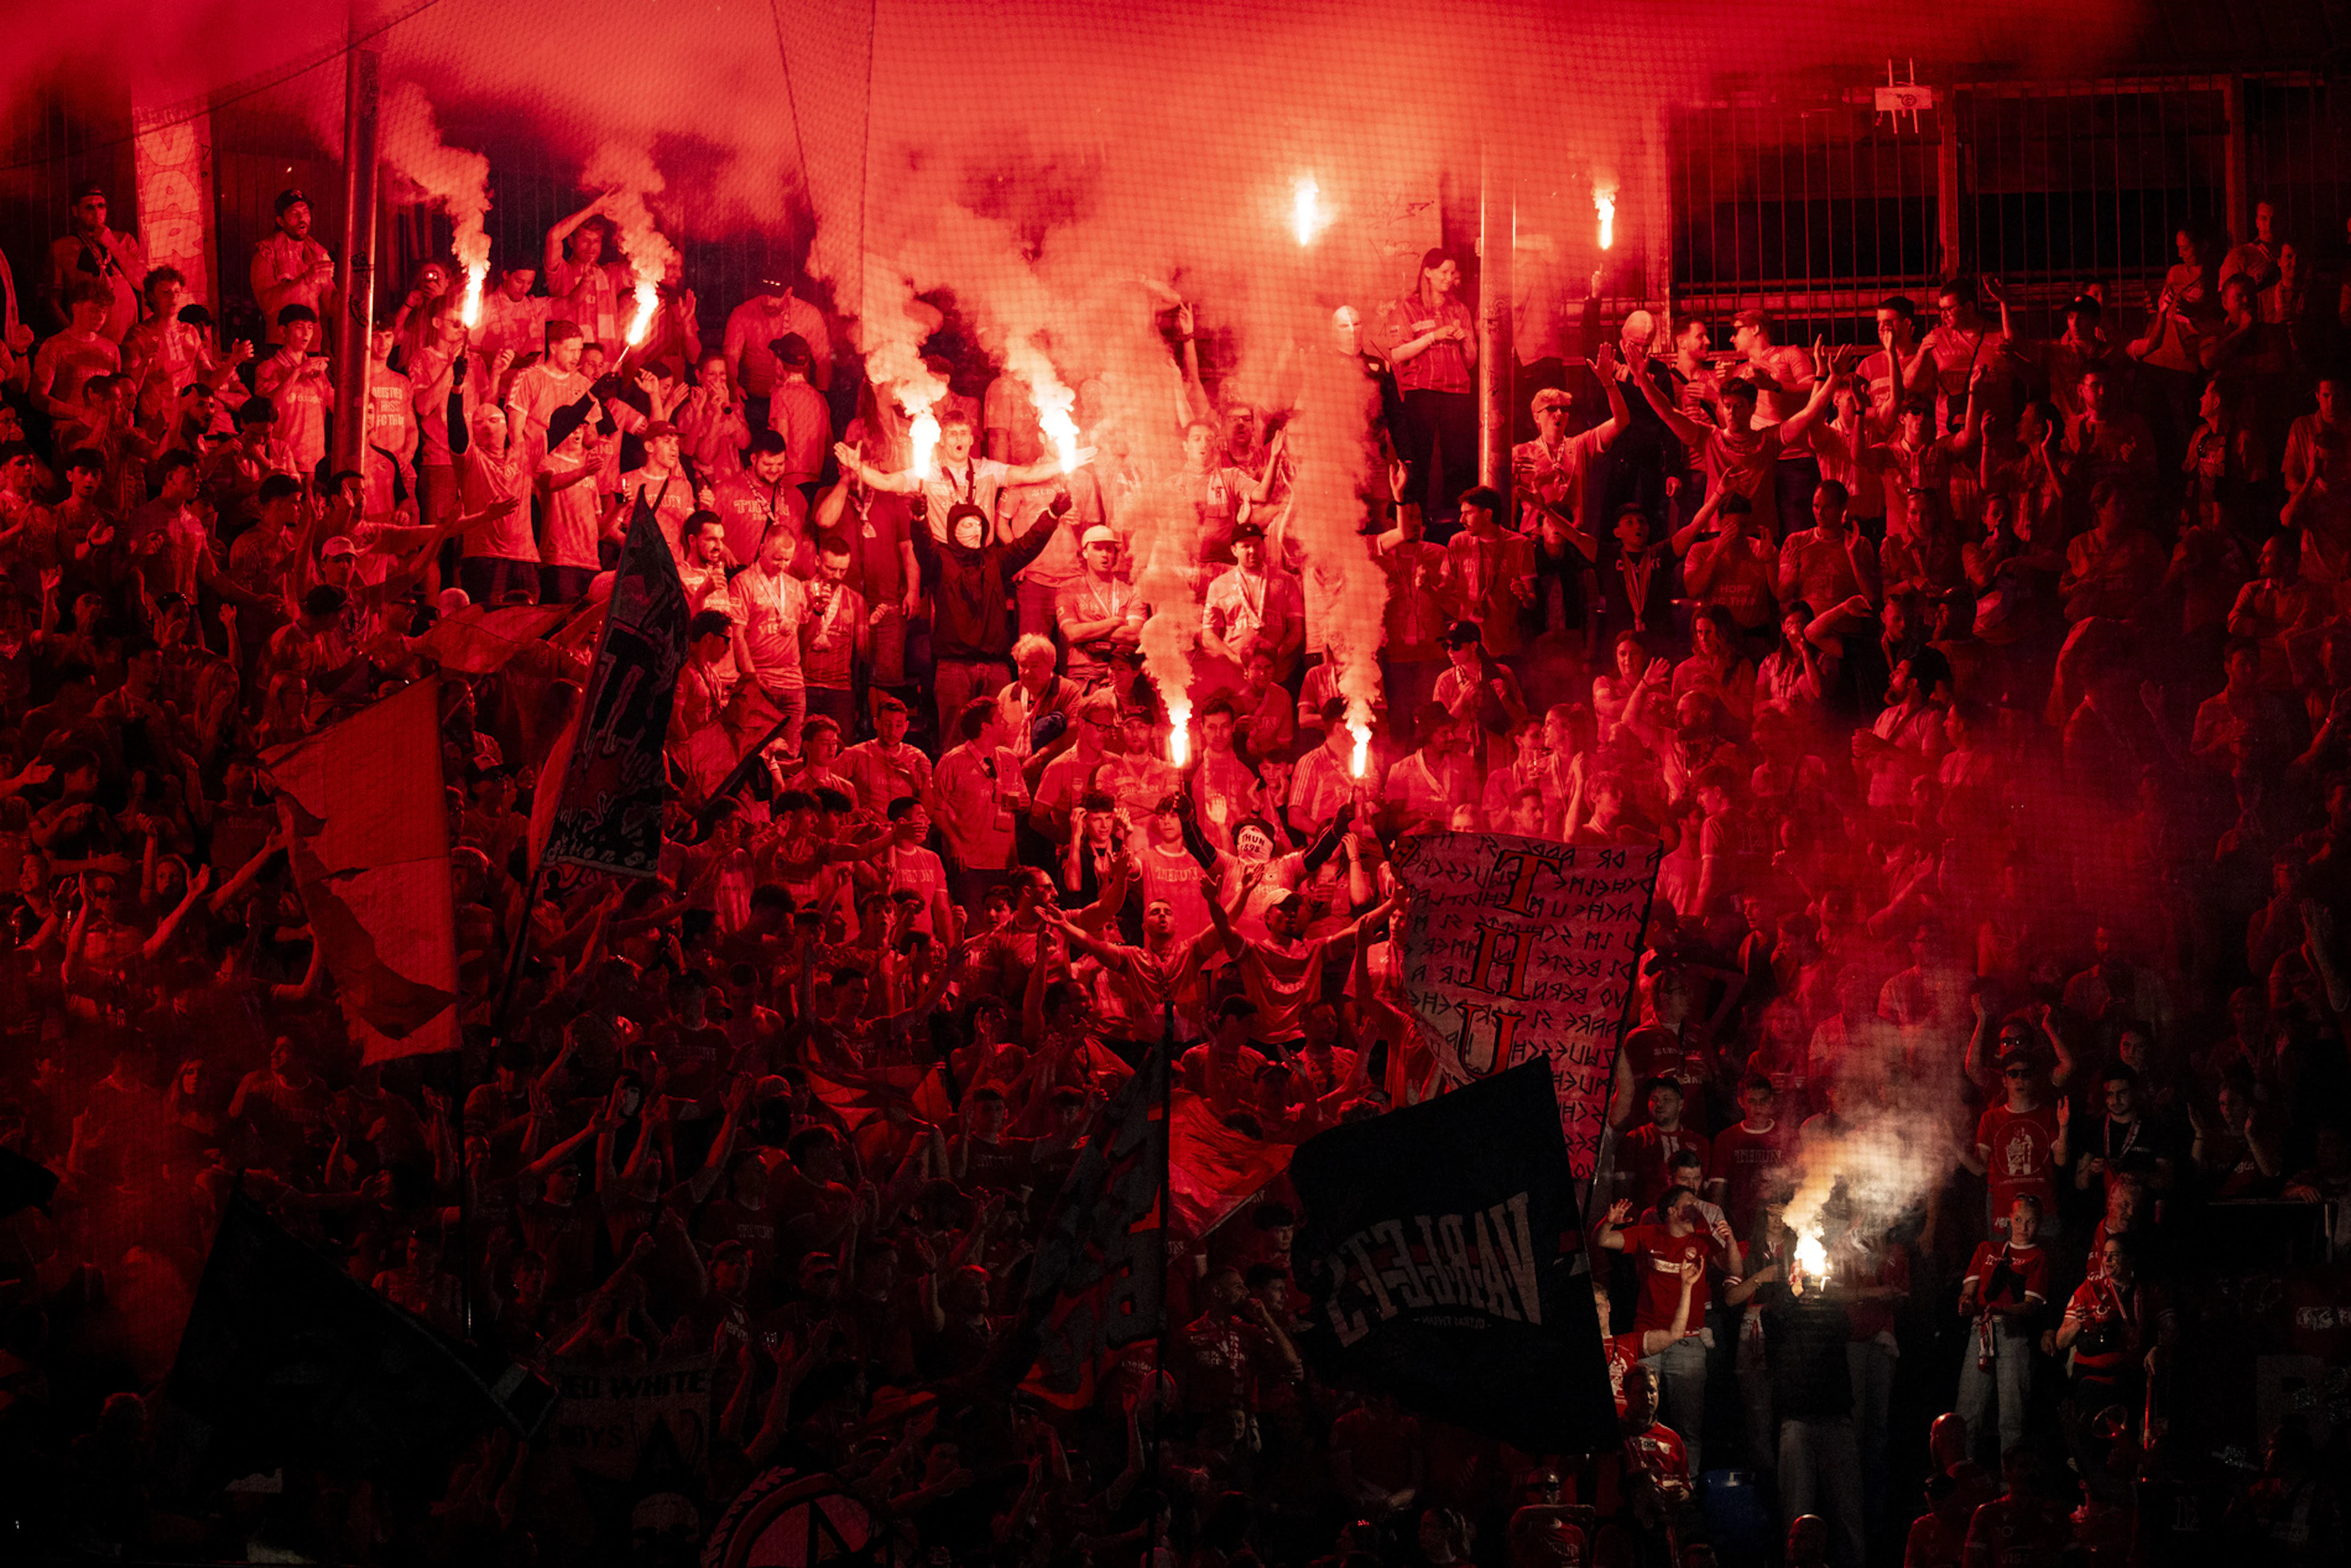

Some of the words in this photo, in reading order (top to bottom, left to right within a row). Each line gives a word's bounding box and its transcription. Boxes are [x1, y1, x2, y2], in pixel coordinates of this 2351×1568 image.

[647, 494, 681, 508] TUN
[734, 500, 789, 516] THN
[1242, 833, 1265, 847] THUN
[1155, 866, 1198, 882] THUN
[1734, 1149, 1782, 1164] THUN
[609, 1368, 708, 1399] WHITE
